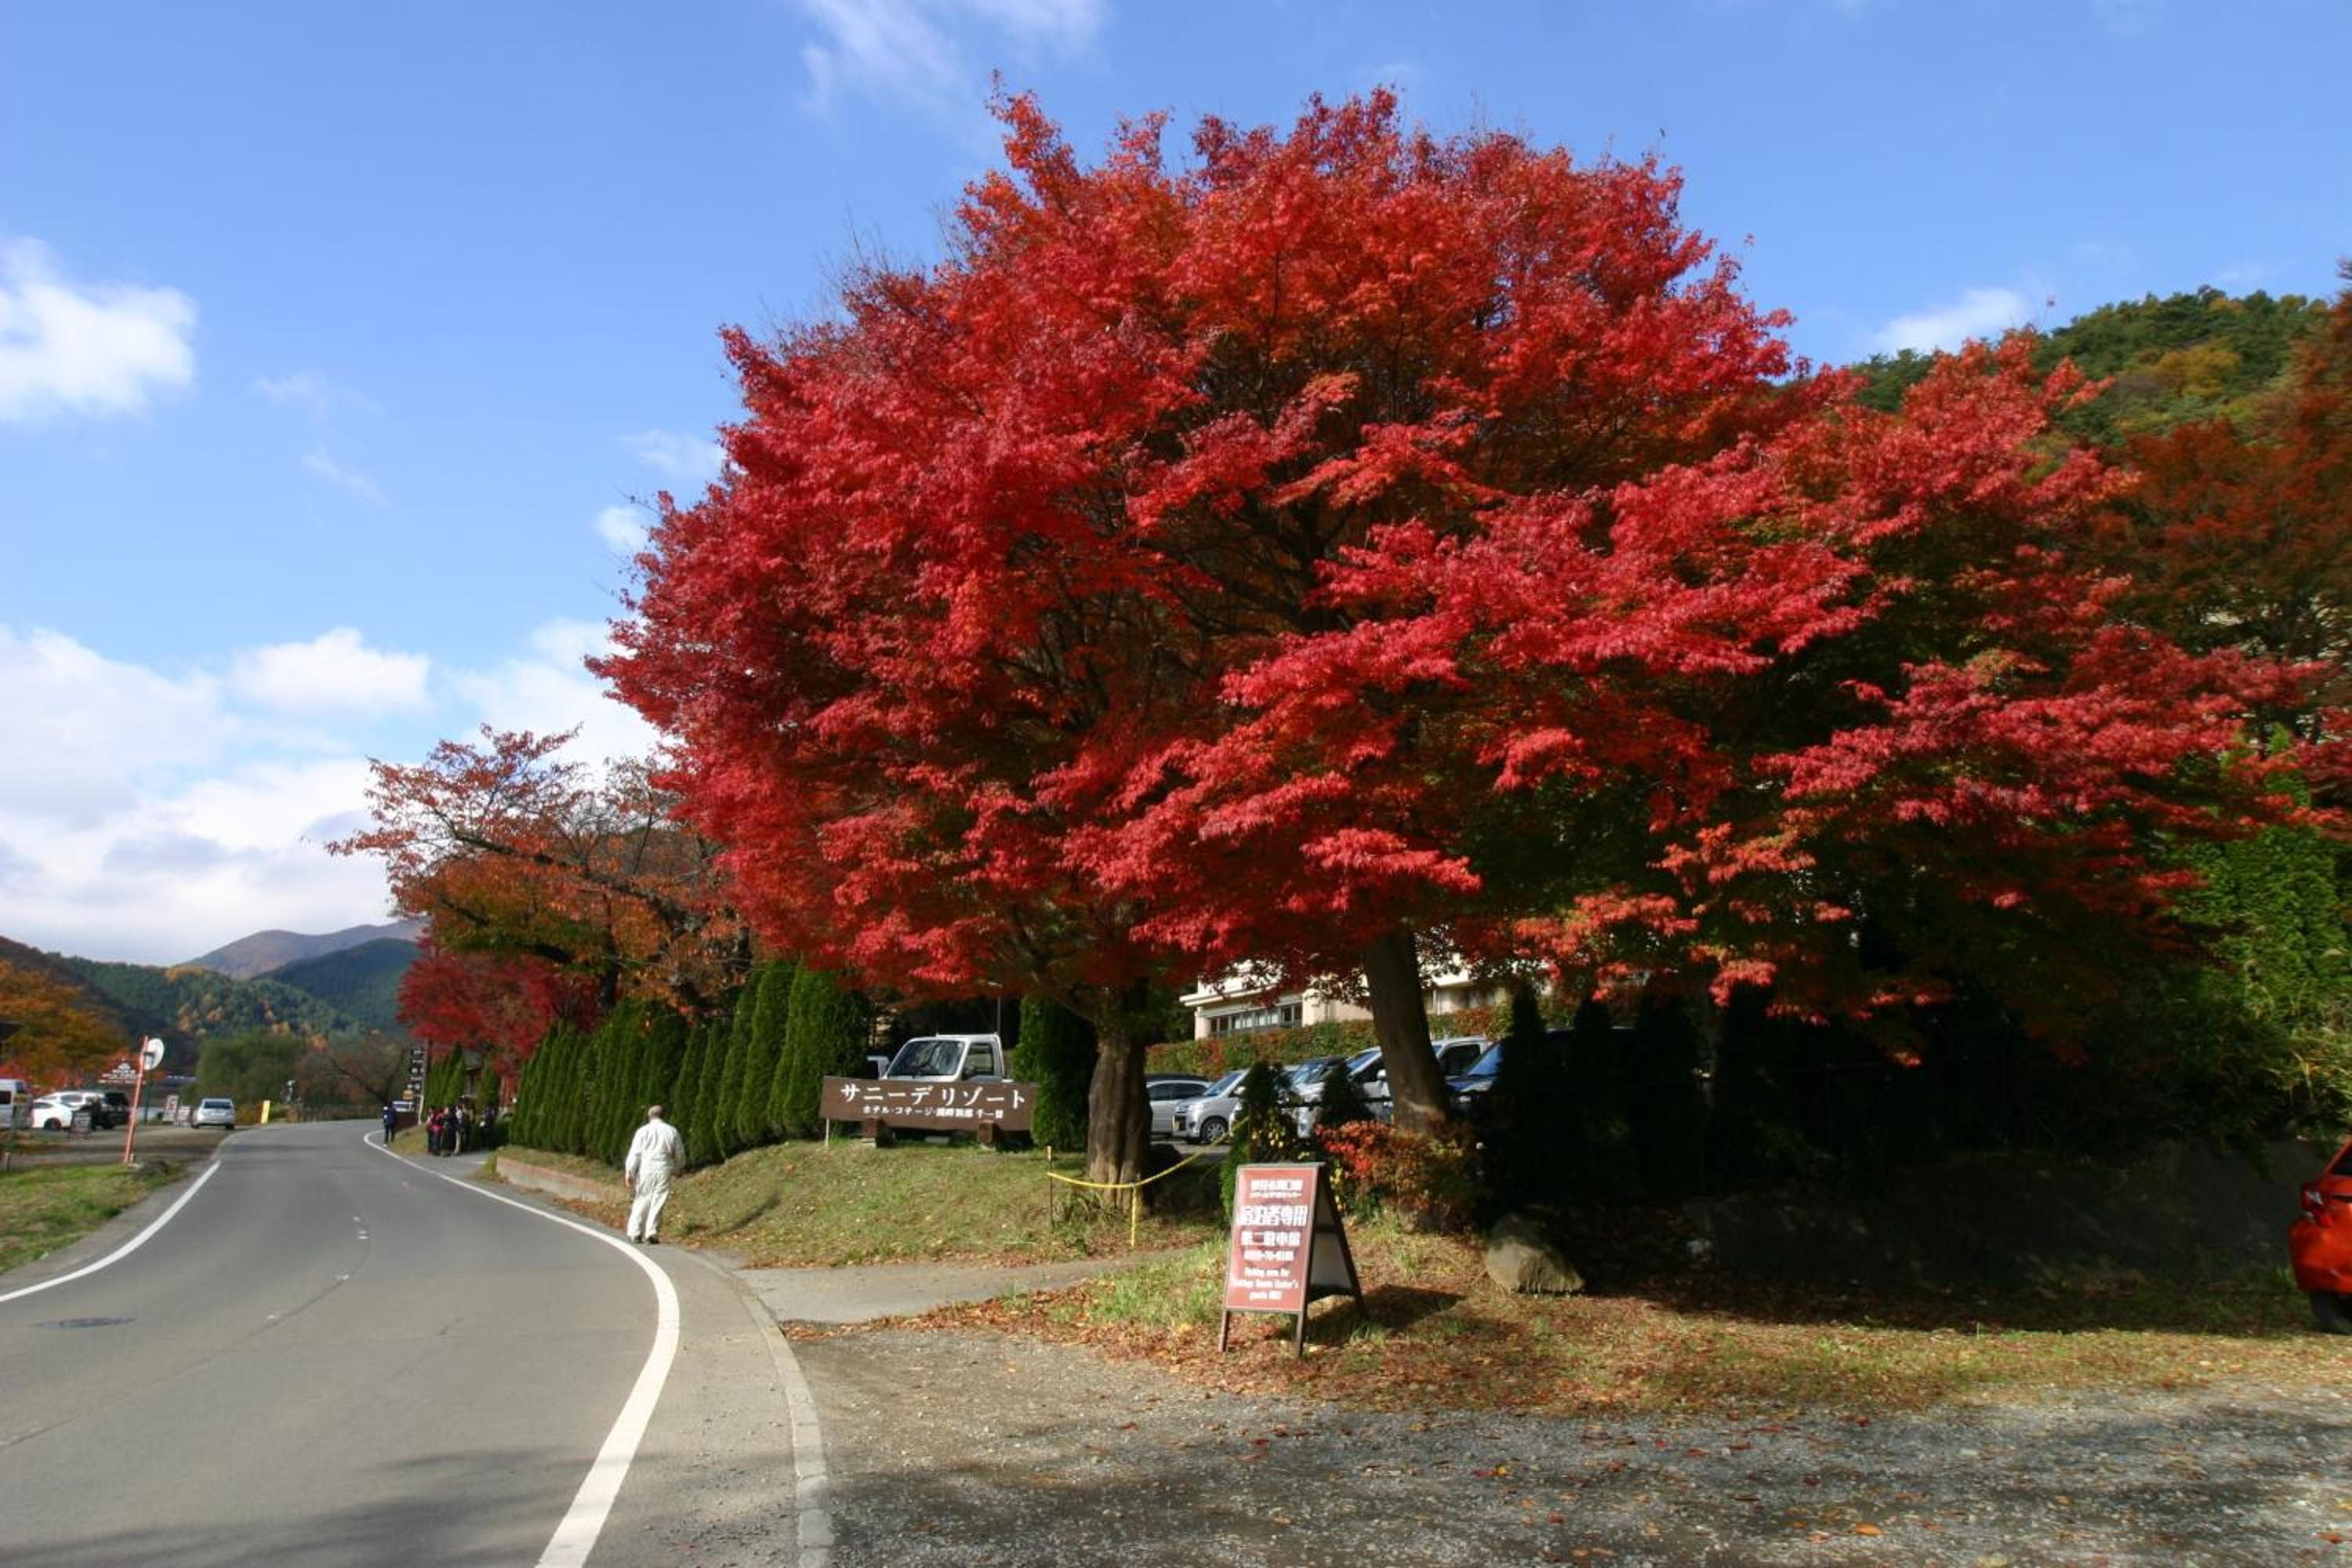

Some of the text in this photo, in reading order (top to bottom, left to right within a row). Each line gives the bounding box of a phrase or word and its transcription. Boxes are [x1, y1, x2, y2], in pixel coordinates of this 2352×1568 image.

[840, 1083, 1025, 1110] サニーデリゾート
[1239, 1205, 1308, 1226] 宿泊者専用
